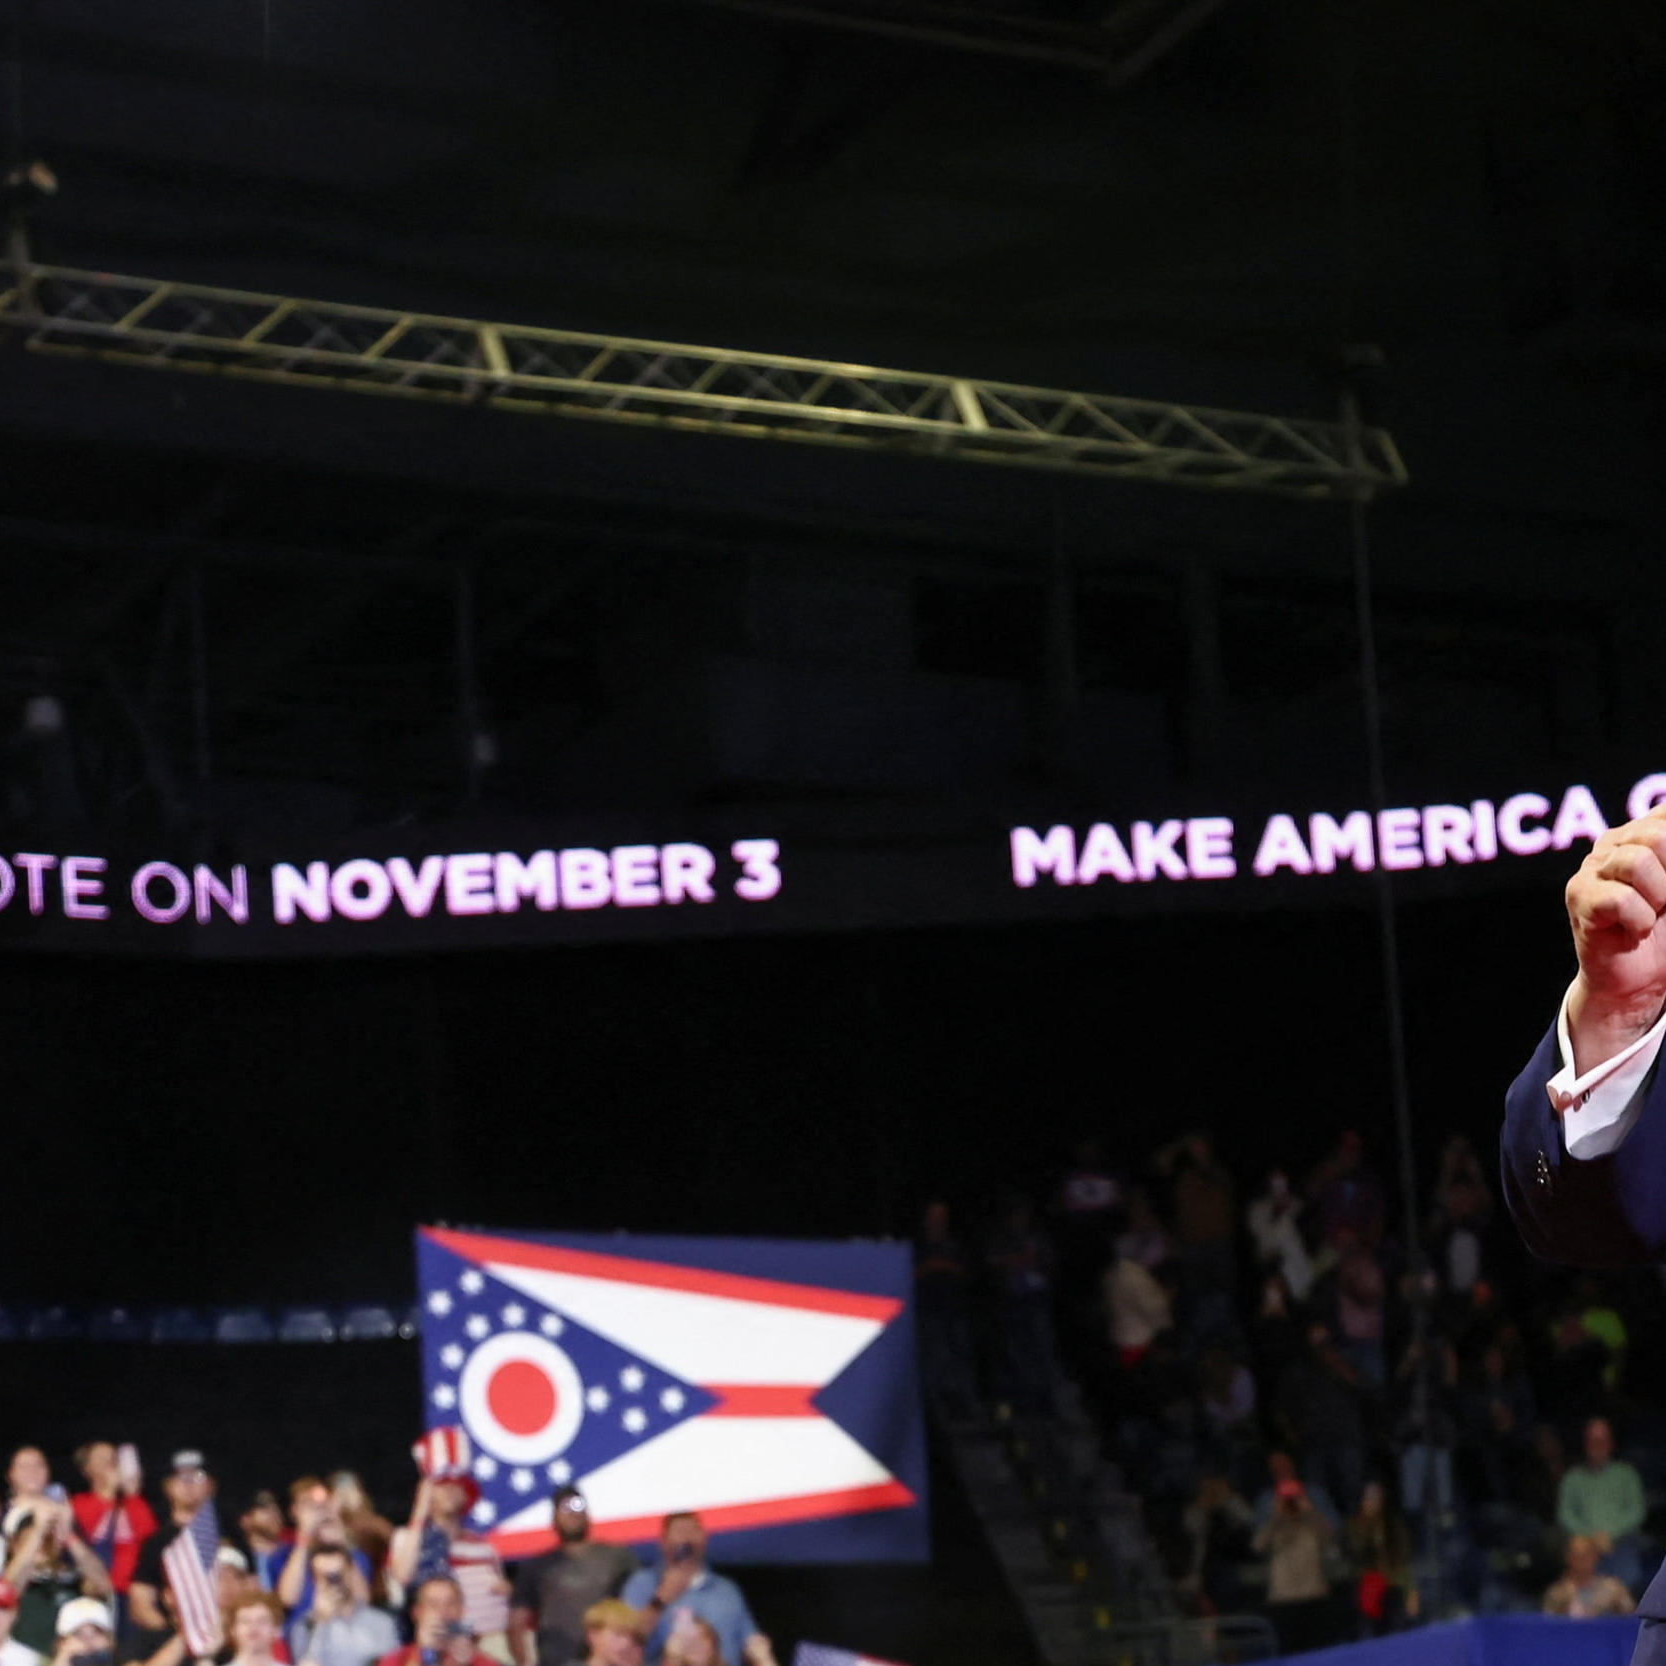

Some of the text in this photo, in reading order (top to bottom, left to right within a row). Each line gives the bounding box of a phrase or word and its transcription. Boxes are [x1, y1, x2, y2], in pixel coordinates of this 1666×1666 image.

[131, 860, 249, 924] ON
[271, 841, 717, 925] NOVEMBER
[731, 838, 782, 902] 3
[1010, 816, 1237, 888] MAKE
[1253, 783, 1611, 876] AMERICA
